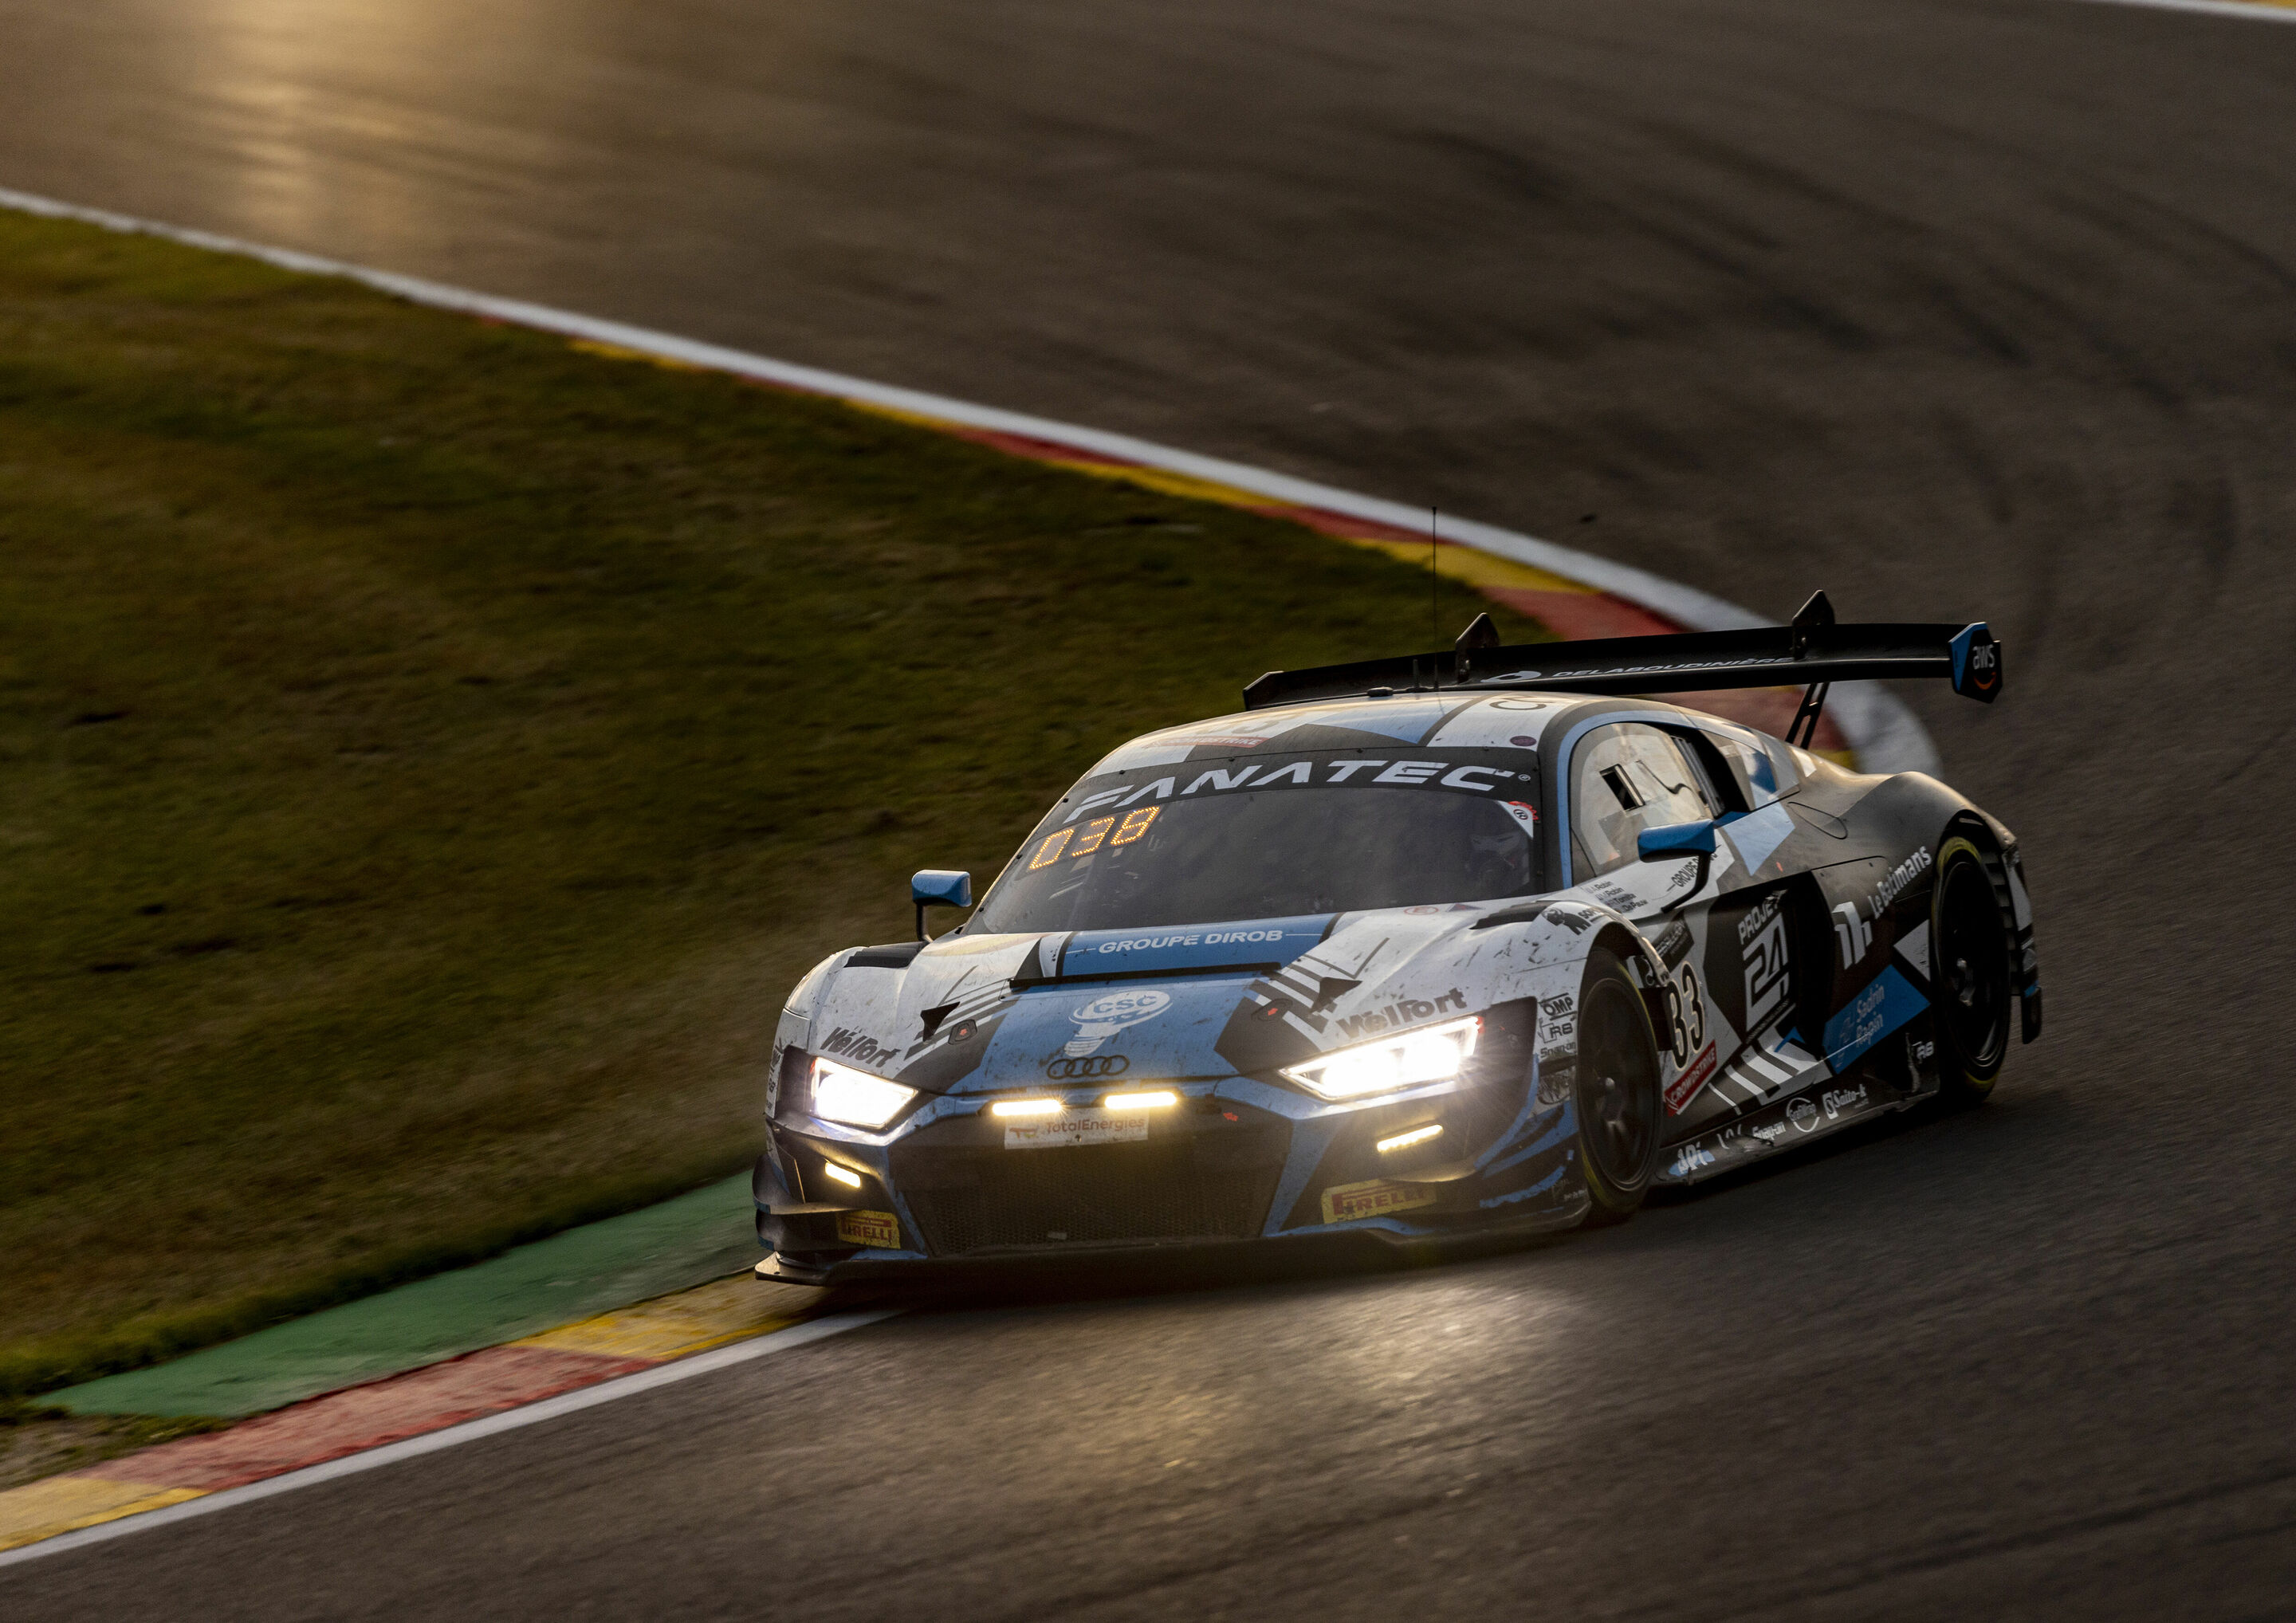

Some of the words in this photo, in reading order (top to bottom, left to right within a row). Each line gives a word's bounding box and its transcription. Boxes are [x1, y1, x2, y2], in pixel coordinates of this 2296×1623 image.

[1972, 643, 1995, 670] aws
[1063, 759, 1516, 824] FANATEC
[1098, 934, 1201, 954] GROUPE
[1204, 929, 1284, 945] DIROB
[1093, 996, 1158, 1014] CSC
[1543, 996, 1574, 1016] OMP
[1549, 1022, 1573, 1039] R8
[1044, 1118, 1146, 1134] TotalEnergies
